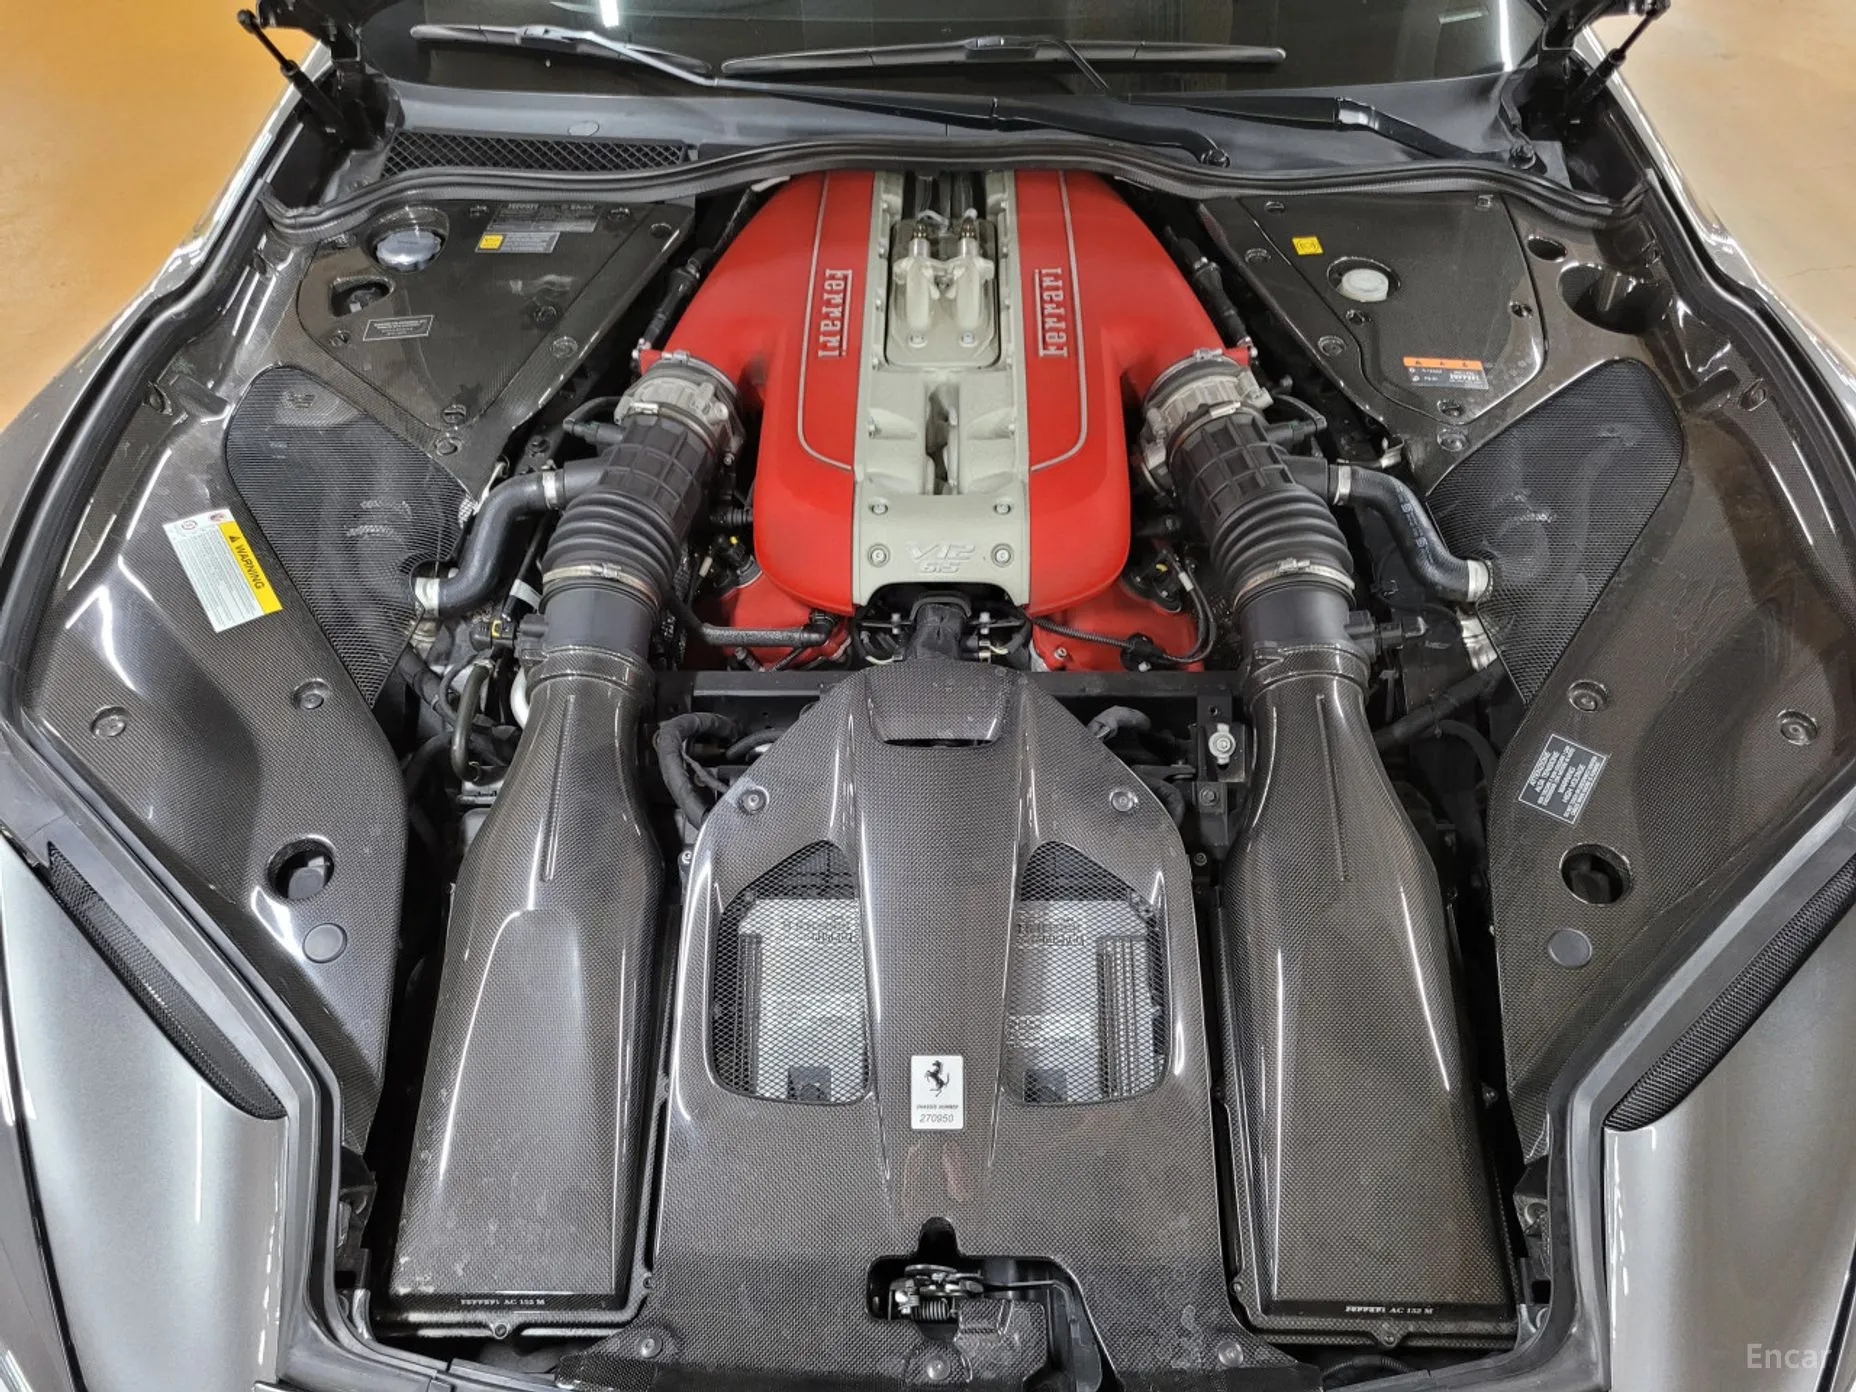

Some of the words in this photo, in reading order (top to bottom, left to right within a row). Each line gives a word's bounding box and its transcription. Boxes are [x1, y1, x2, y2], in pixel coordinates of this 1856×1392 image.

[818, 269, 852, 357] Ferrari
[1034, 268, 1068, 357] Ferrari
[234, 544, 265, 590] WARNING
[919, 1113, 955, 1124] 270950
